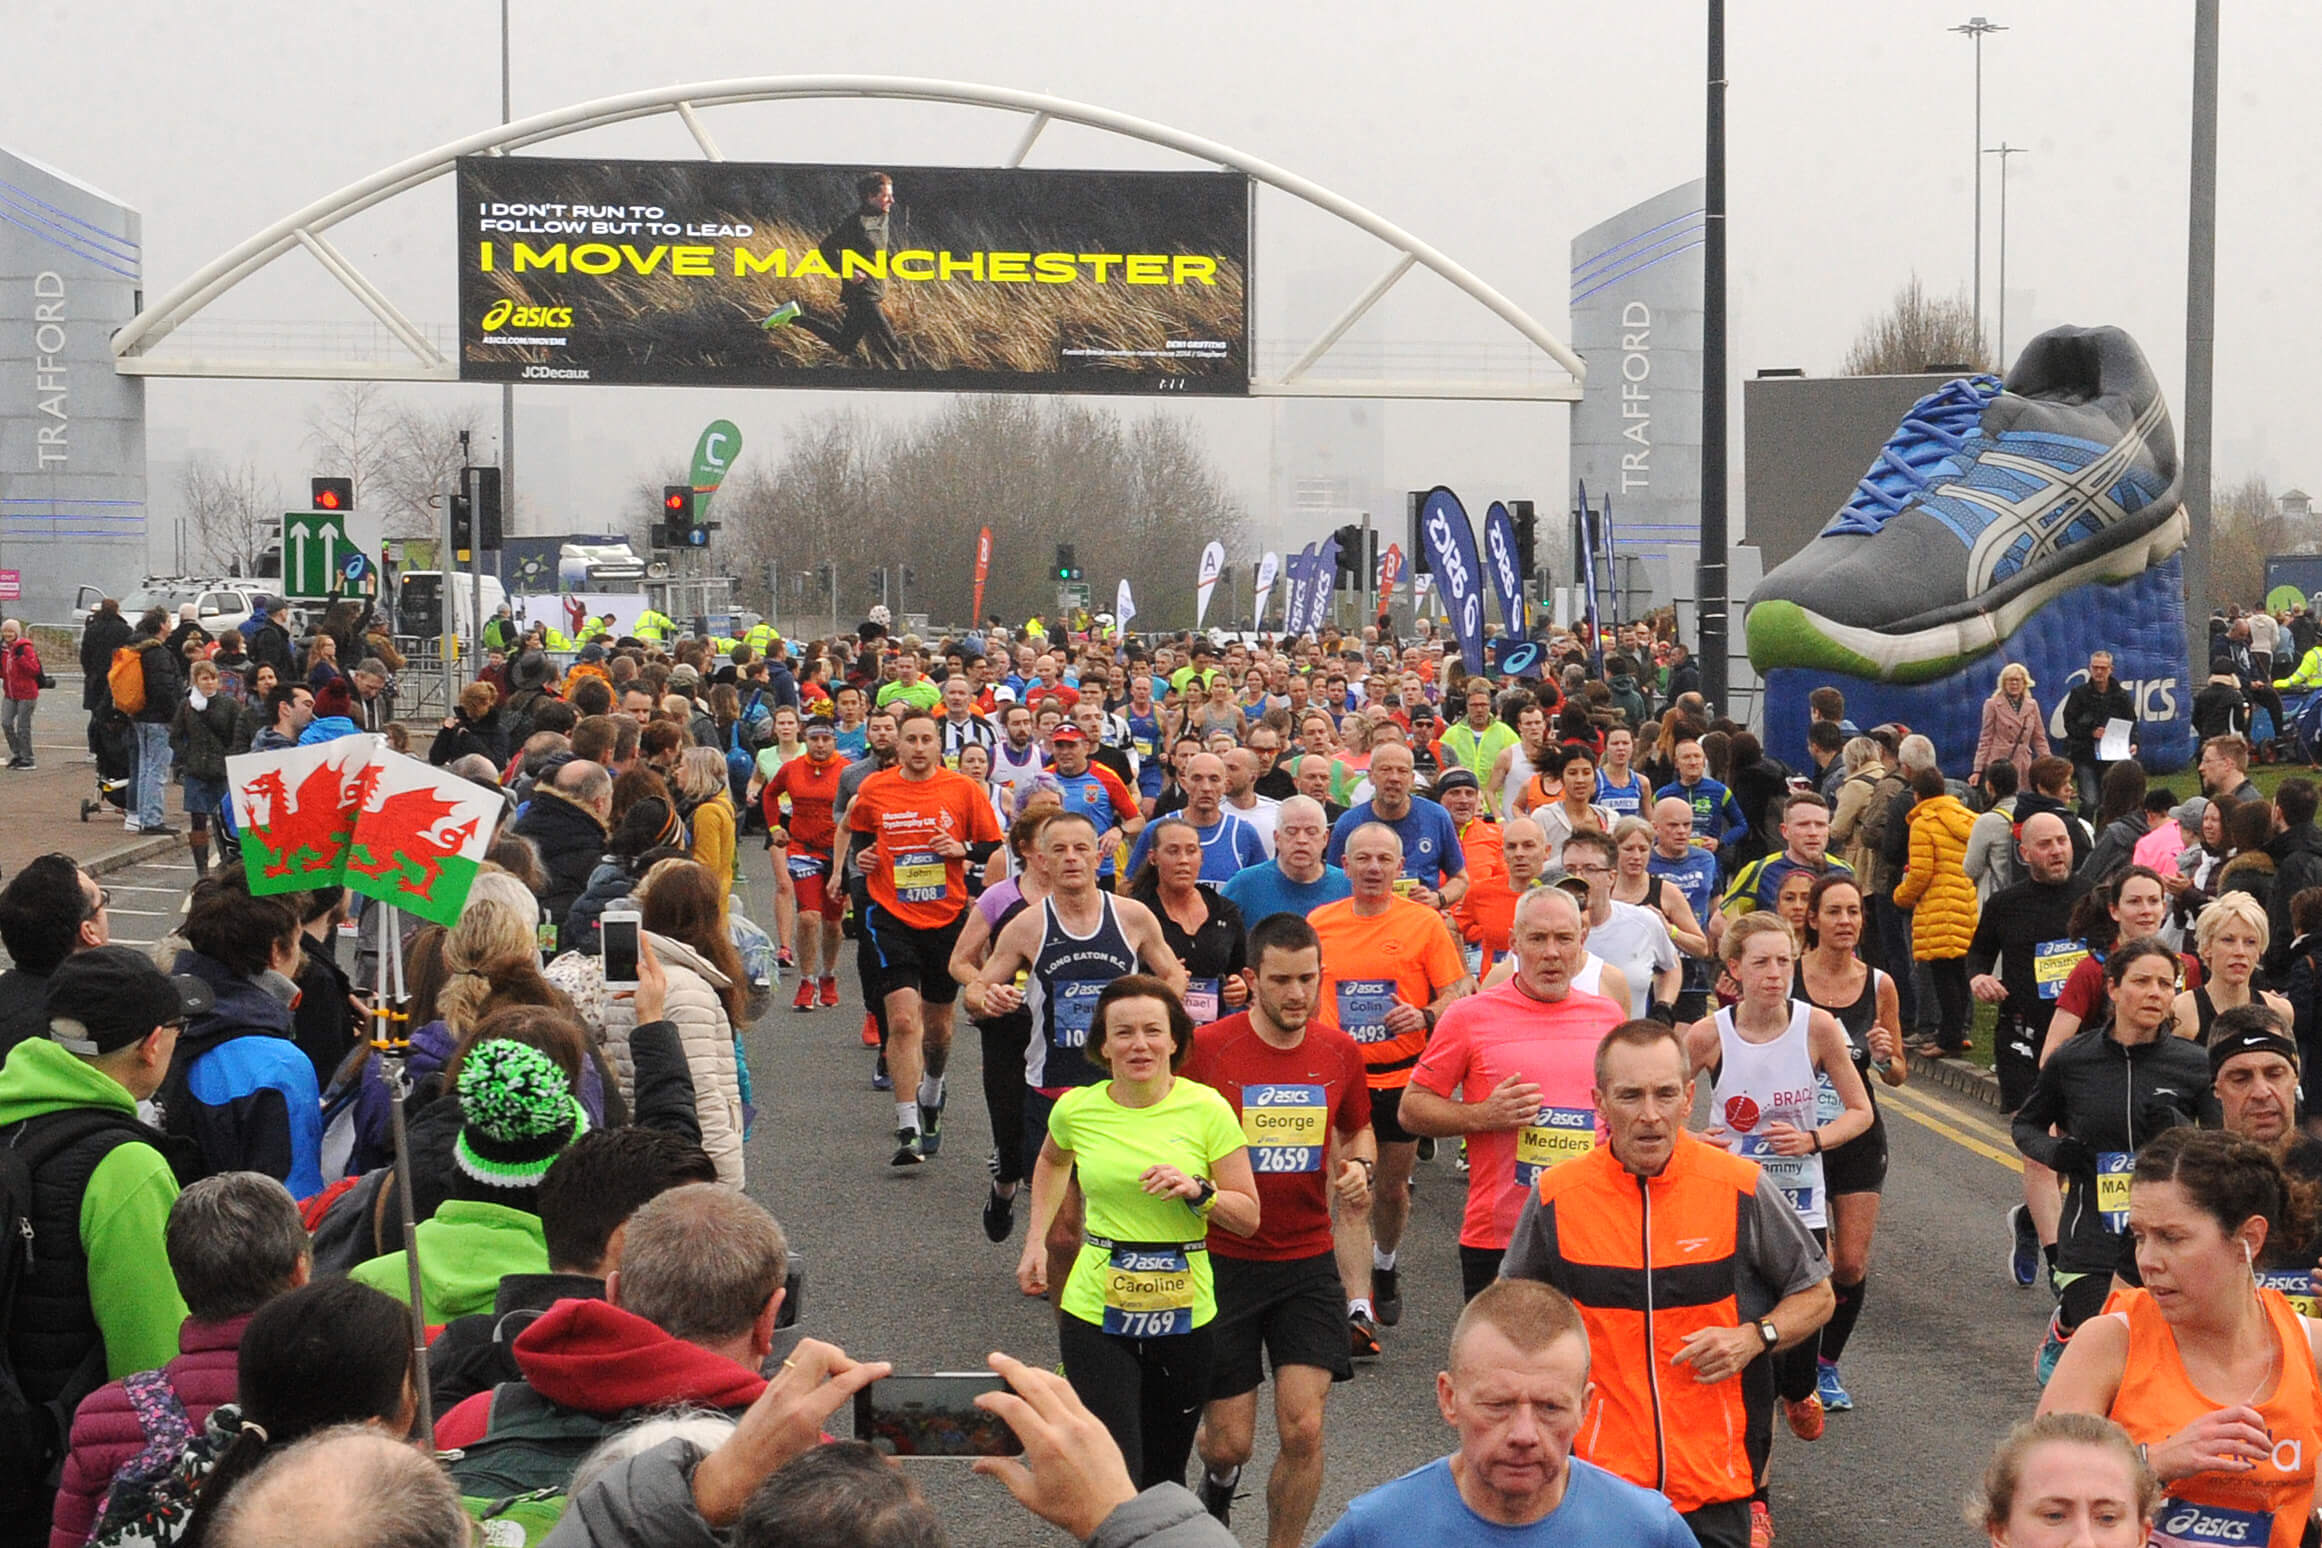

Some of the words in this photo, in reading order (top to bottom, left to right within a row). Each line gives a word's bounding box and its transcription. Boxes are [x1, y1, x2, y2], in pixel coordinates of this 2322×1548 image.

[480, 203, 486, 215] I
[492, 203, 567, 217] DON'T
[572, 205, 625, 218] RUN
[630, 206, 664, 219] TO
[480, 219, 587, 234] FOLLOW
[592, 221, 643, 235] BUT
[646, 223, 682, 236] TO
[686, 224, 753, 237] LEAD
[480, 241, 493, 272] I
[513, 242, 715, 276] MOVE
[734, 247, 1217, 285] MANCHESTER
[35, 271, 67, 469] TRAFFORD
[521, 366, 590, 379] JCDecaux
[1621, 302, 1650, 494] TRAFFORD
[706, 433, 727, 466] C
[1204, 551, 1216, 572] A
[907, 887, 937, 901] 4708
[1044, 955, 1071, 975] LONG
[1073, 952, 1107, 961] EATON
[1185, 998, 1211, 1008] hael
[1350, 1001, 1383, 1012] Colin
[1066, 1030, 1086, 1047] 10
[1255, 1114, 1314, 1131] George
[1524, 1132, 1589, 1151] Medders
[1259, 1147, 1309, 1171] 2659
[1530, 1167, 1542, 1187] 8
[1762, 1163, 1803, 1174] ammy
[1113, 1276, 1184, 1293] Caroline
[1121, 1311, 1175, 1336] 7769
